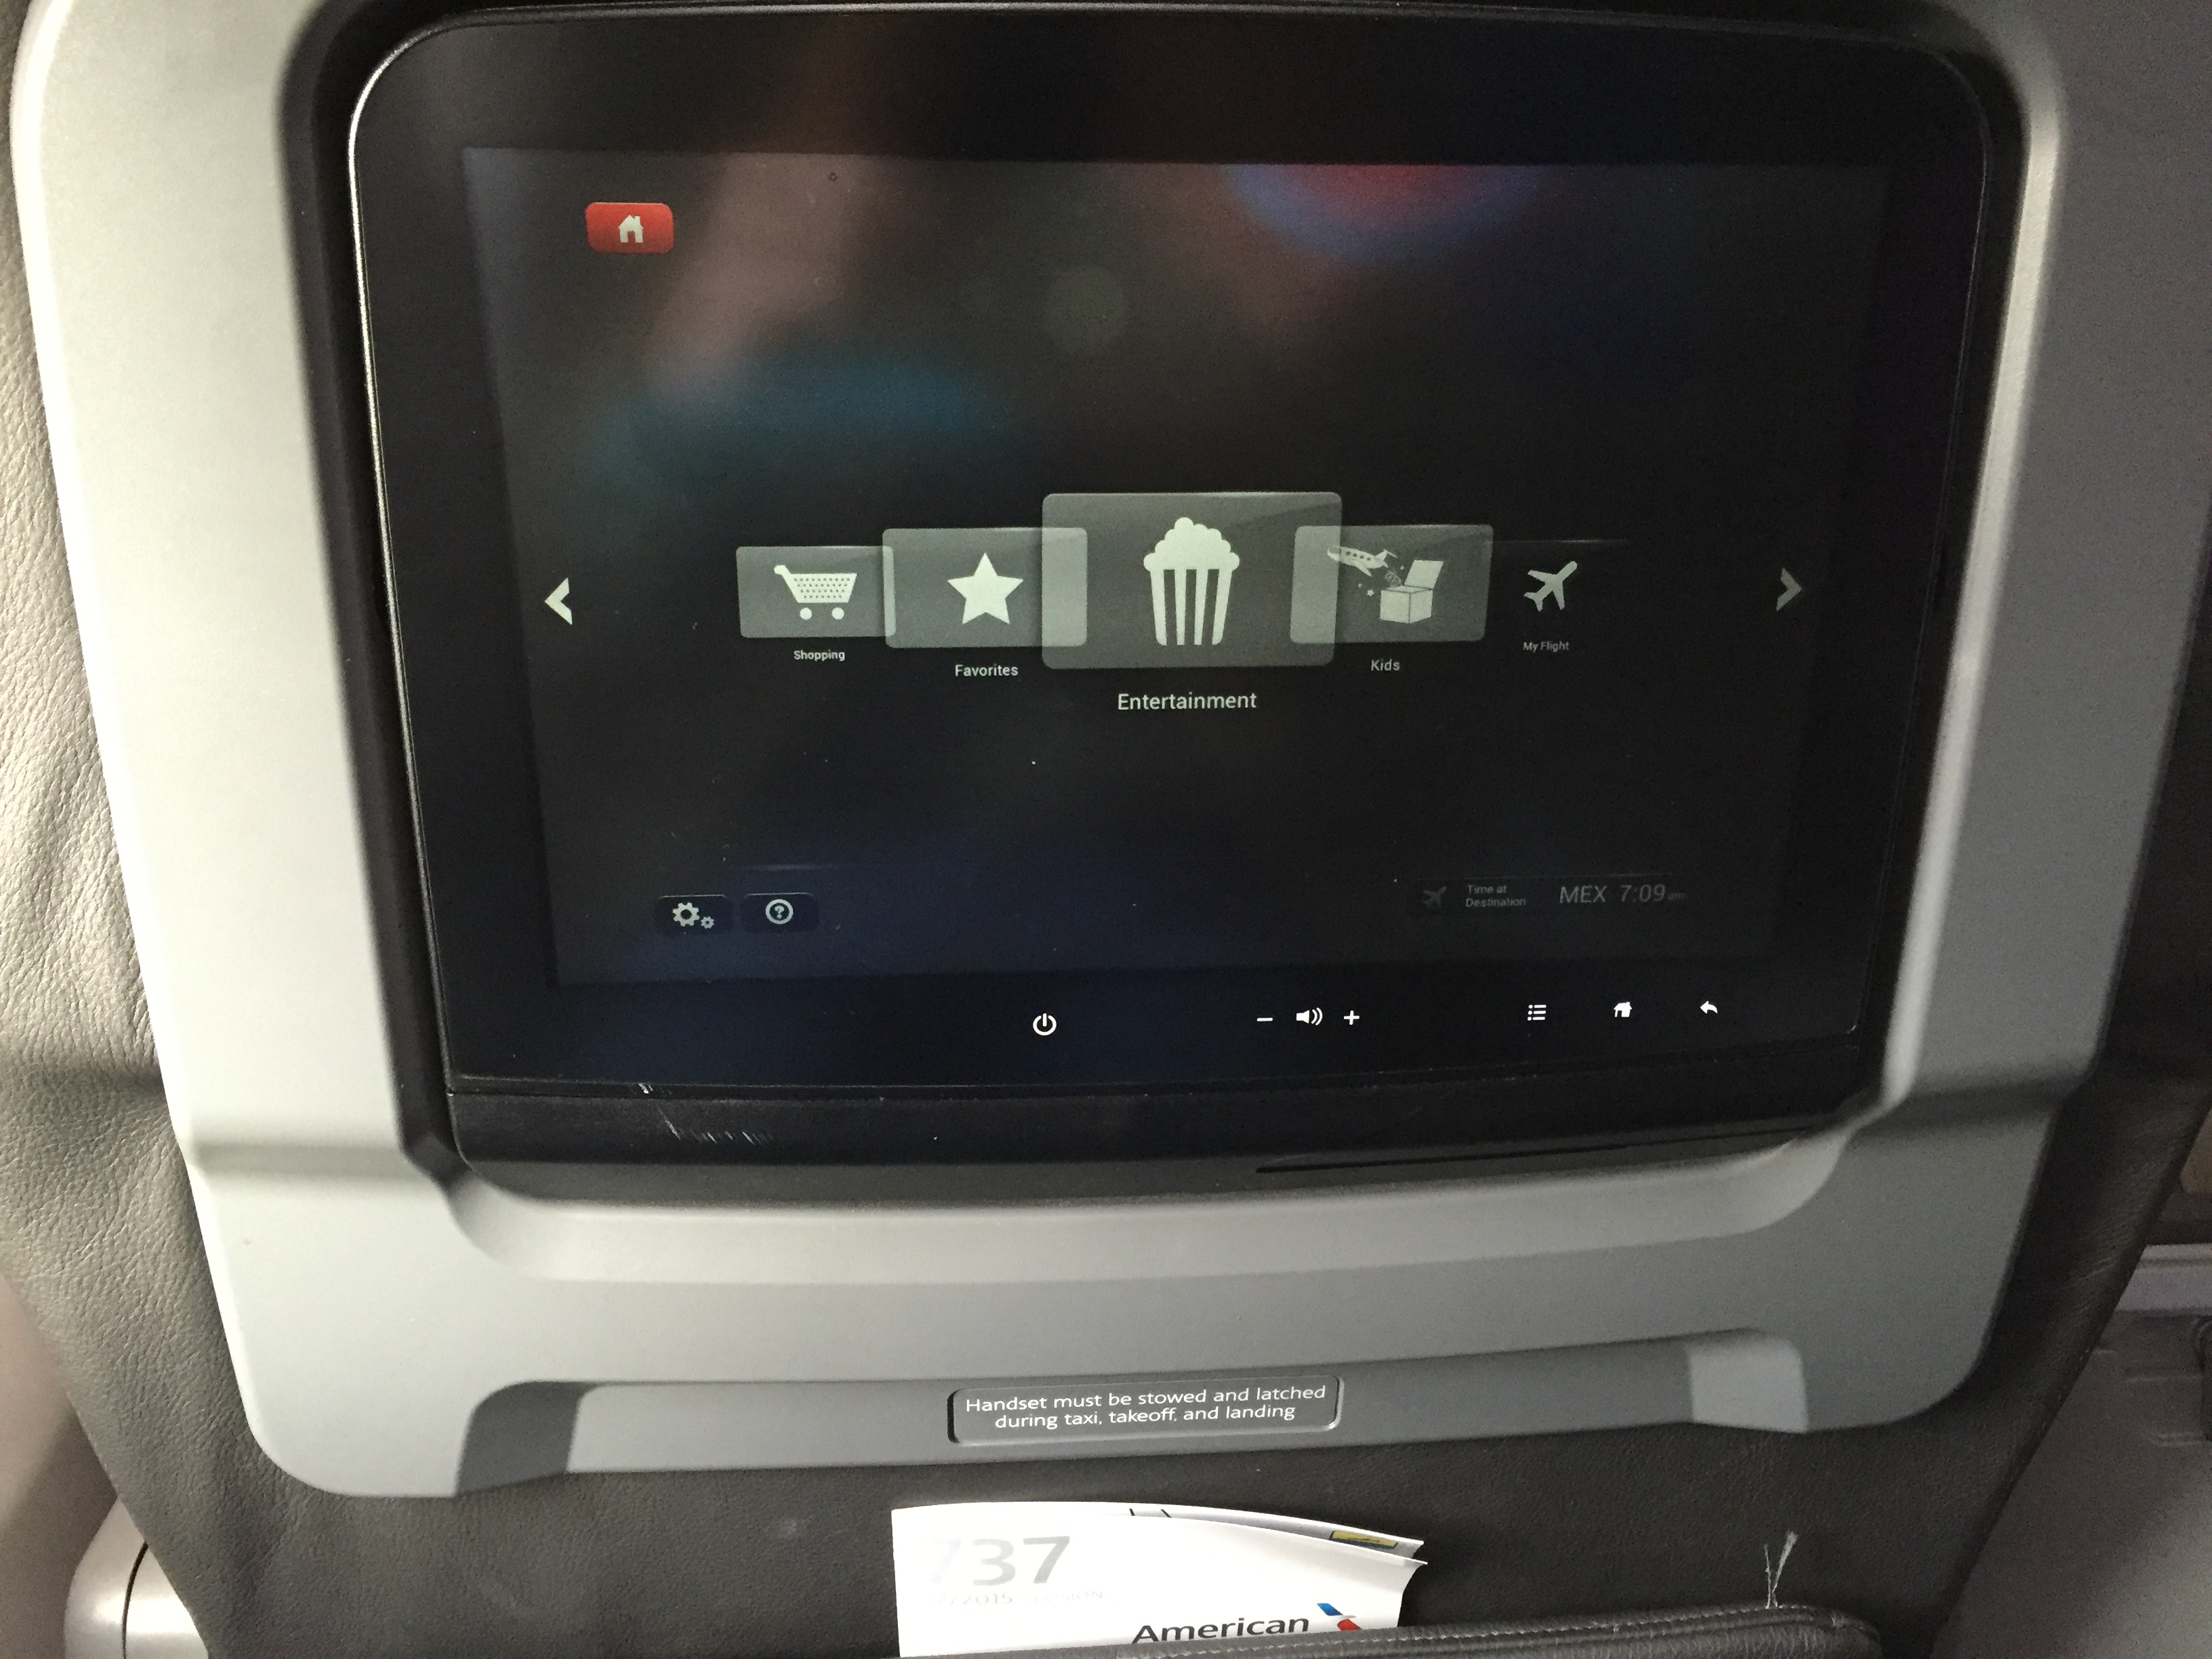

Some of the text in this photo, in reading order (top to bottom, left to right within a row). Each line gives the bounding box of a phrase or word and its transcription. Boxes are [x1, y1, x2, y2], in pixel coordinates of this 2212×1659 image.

[1523, 640, 1570, 653] My Flight
[793, 650, 846, 662] Shopping
[954, 663, 1019, 676] Favorites
[1370, 658, 1401, 671] Kids
[1117, 693, 1258, 711] Entertainment
[1467, 884, 1507, 895] Time at
[1559, 885, 1608, 904] MEX
[1620, 884, 1667, 903] 7:09
[1465, 897, 1527, 908] Destination
[966, 1385, 1326, 1412] Handset must be stowed and latched
[995, 1404, 1296, 1430] during taxi, takeoff, and landing
[923, 1535, 1071, 1586] 737
[1131, 1617, 1309, 1644] American
